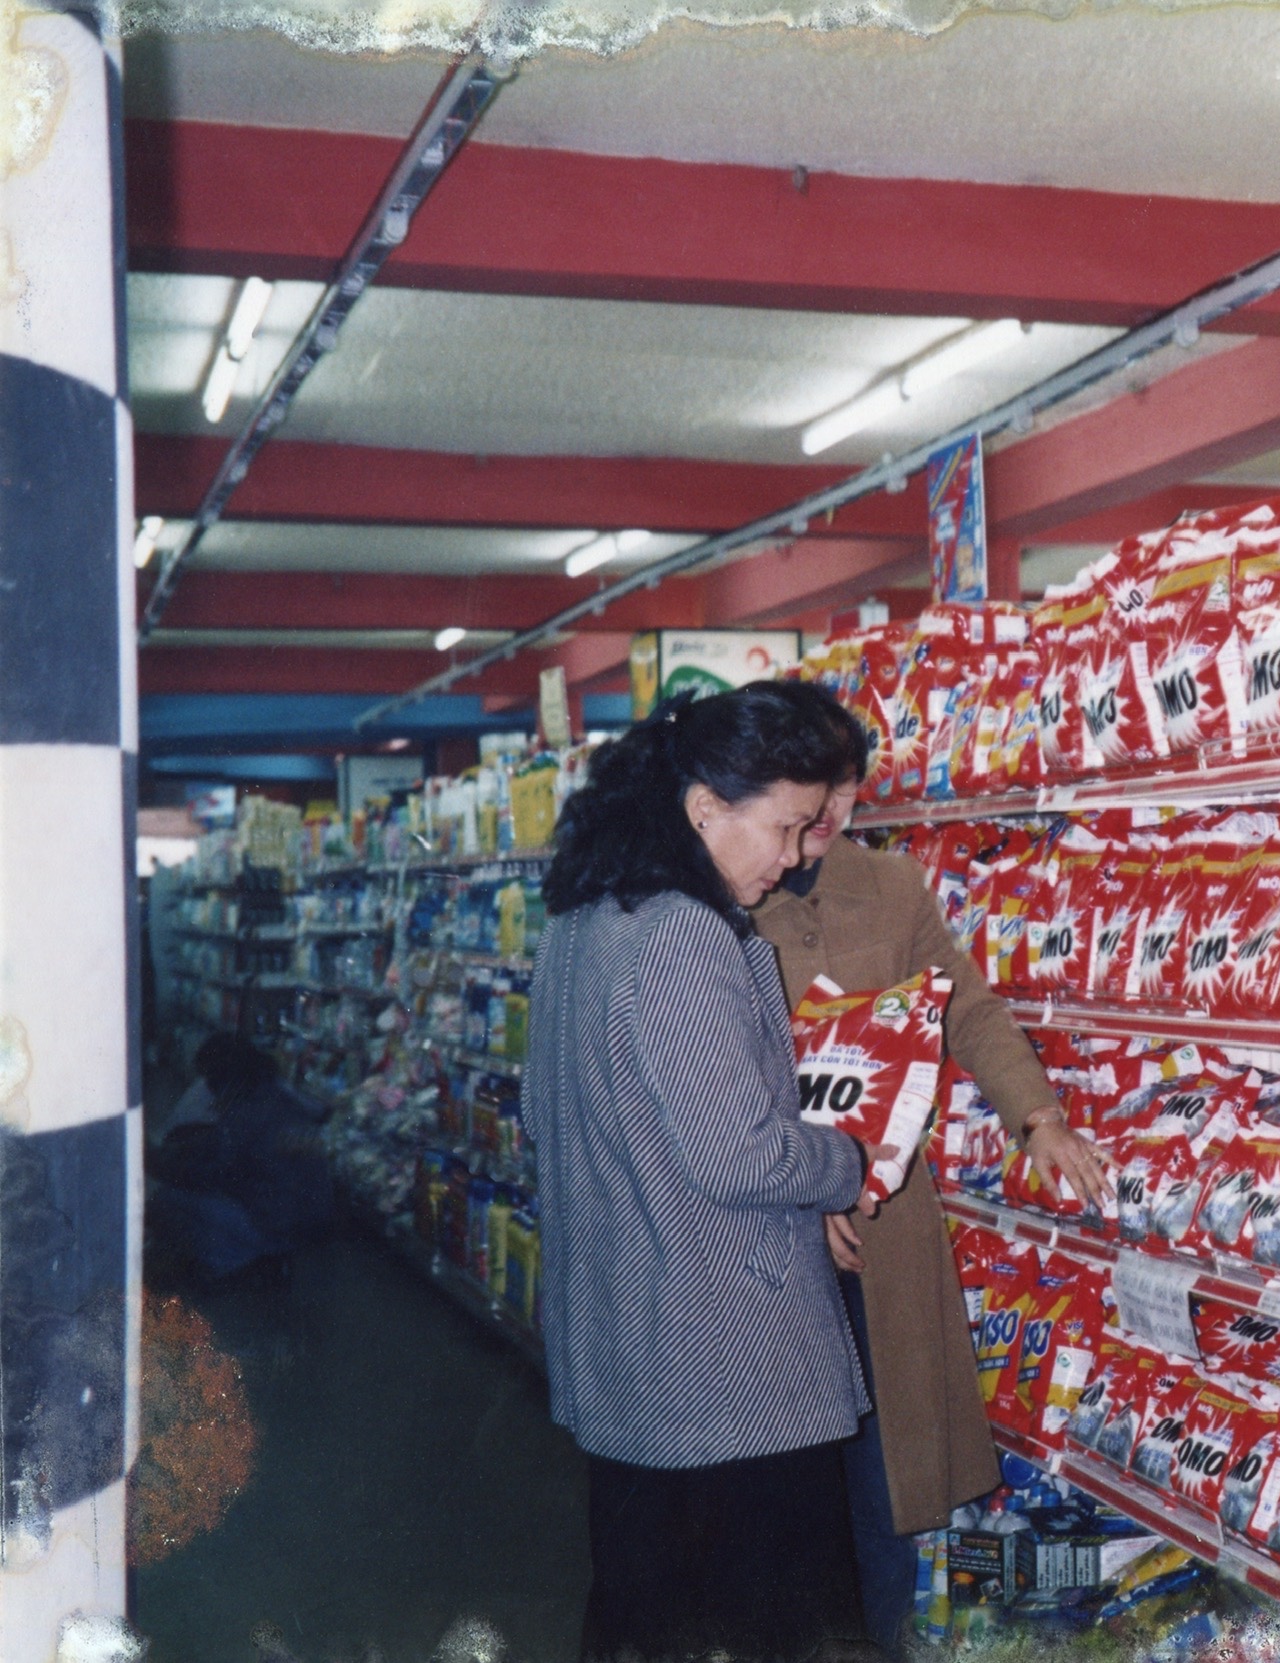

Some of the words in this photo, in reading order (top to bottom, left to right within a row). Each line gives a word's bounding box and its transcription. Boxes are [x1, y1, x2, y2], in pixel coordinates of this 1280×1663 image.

[1190, 933, 1229, 972] OMO
[1229, 1315, 1279, 1343] OMO
[1178, 1437, 1227, 1477] OMO
